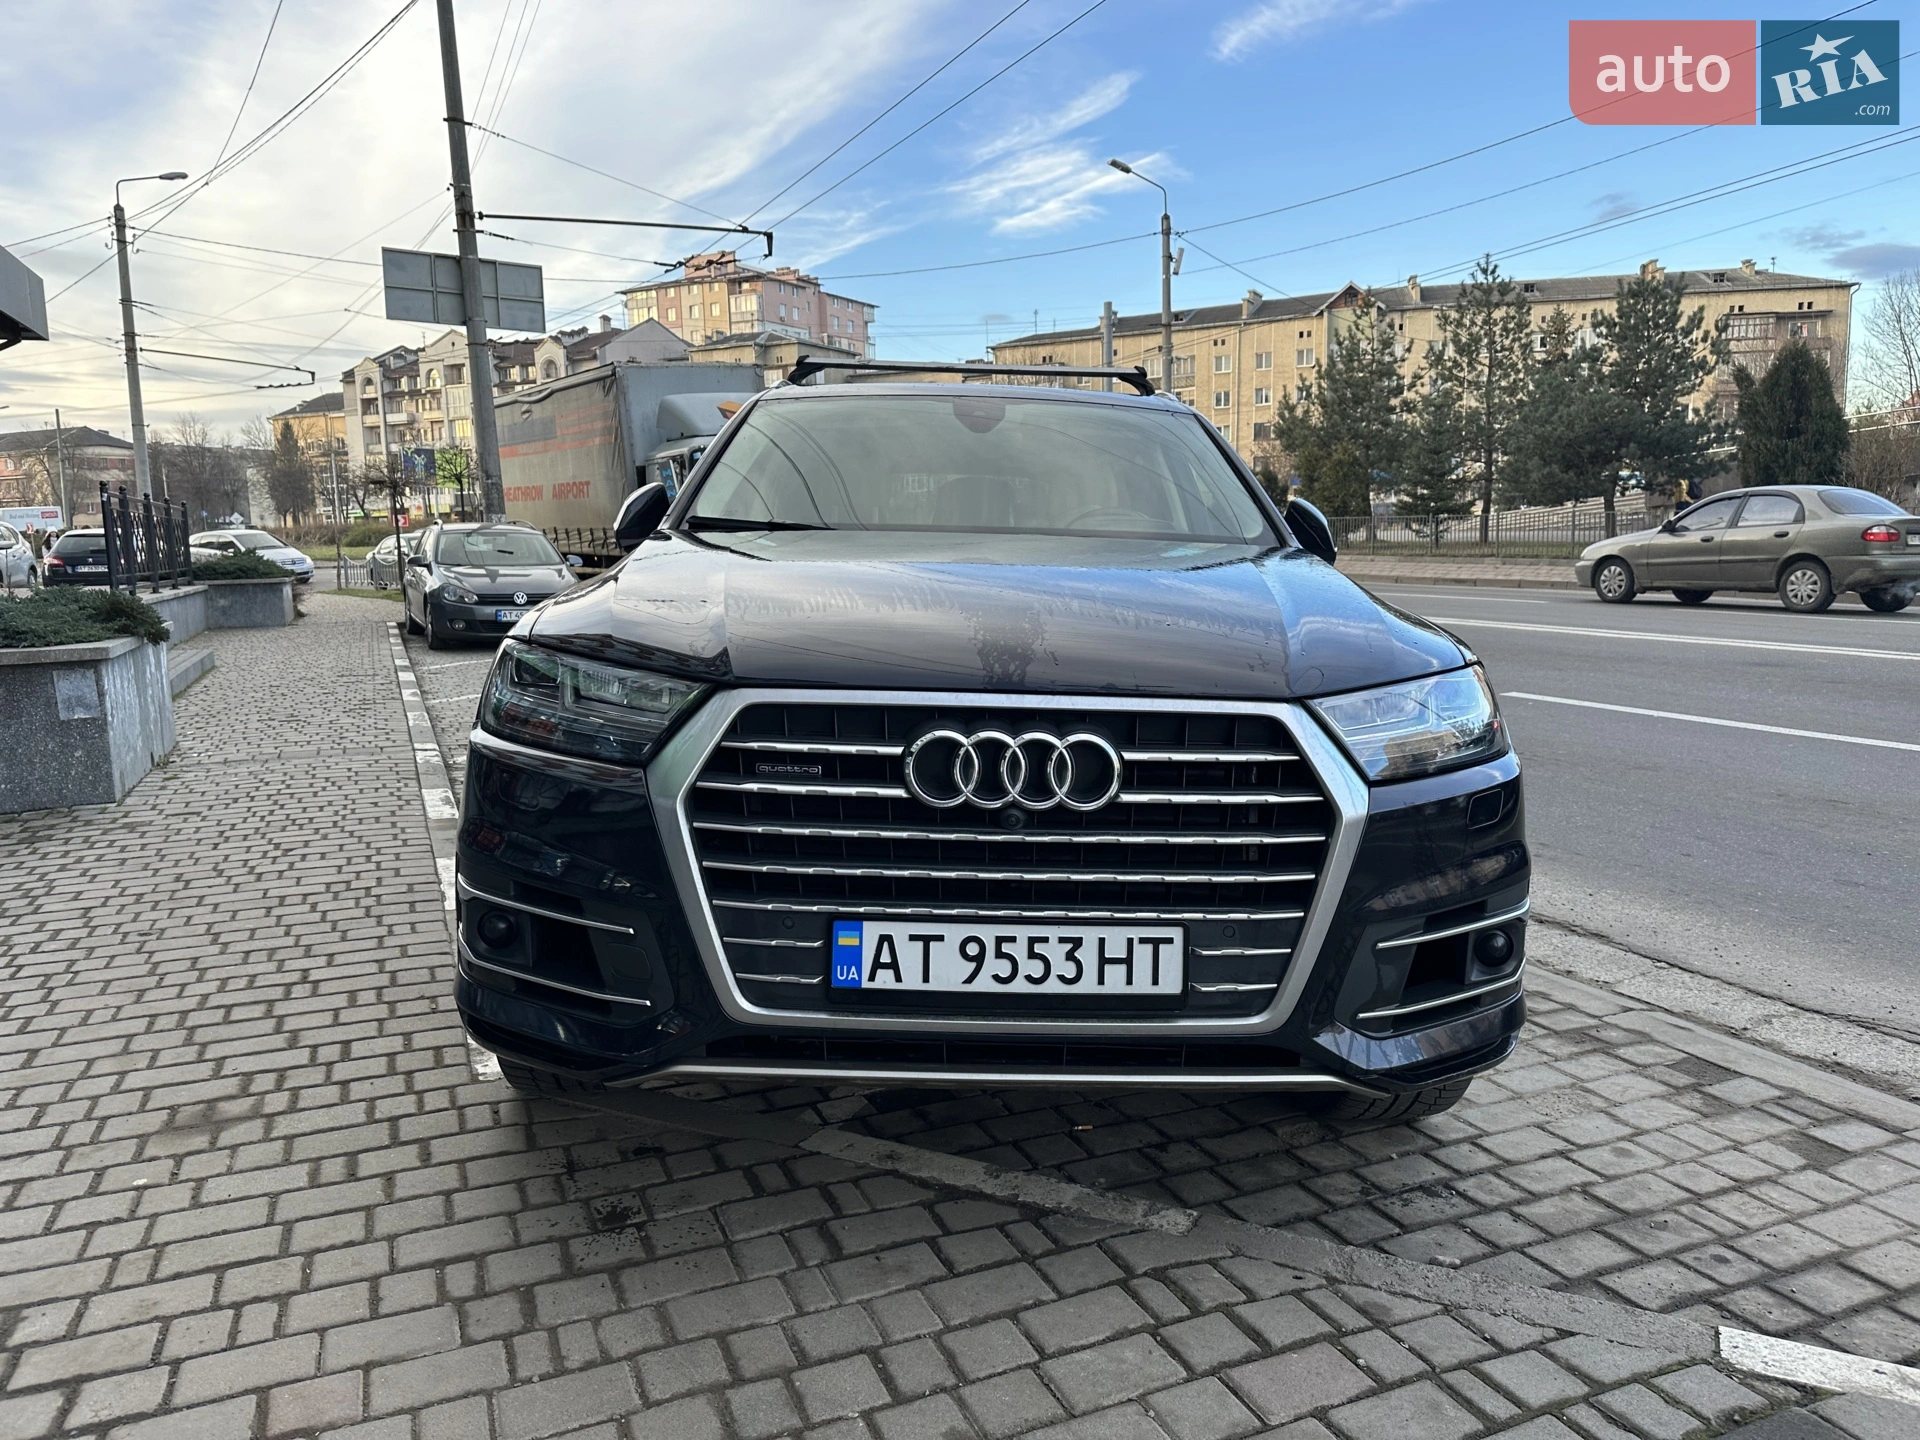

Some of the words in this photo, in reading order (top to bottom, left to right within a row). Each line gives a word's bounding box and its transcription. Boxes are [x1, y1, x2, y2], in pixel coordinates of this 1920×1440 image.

[503, 484, 544, 503] HEATHROW
[552, 480, 591, 500] AIRPORT
[662, 469, 677, 497] MAN
[502, 611, 513, 619] AT
[758, 765, 819, 773] quattro
[867, 933, 945, 984] AT
[957, 934, 1085, 986] 9553
[1097, 936, 1175, 987] HT
[836, 965, 859, 981] UA
